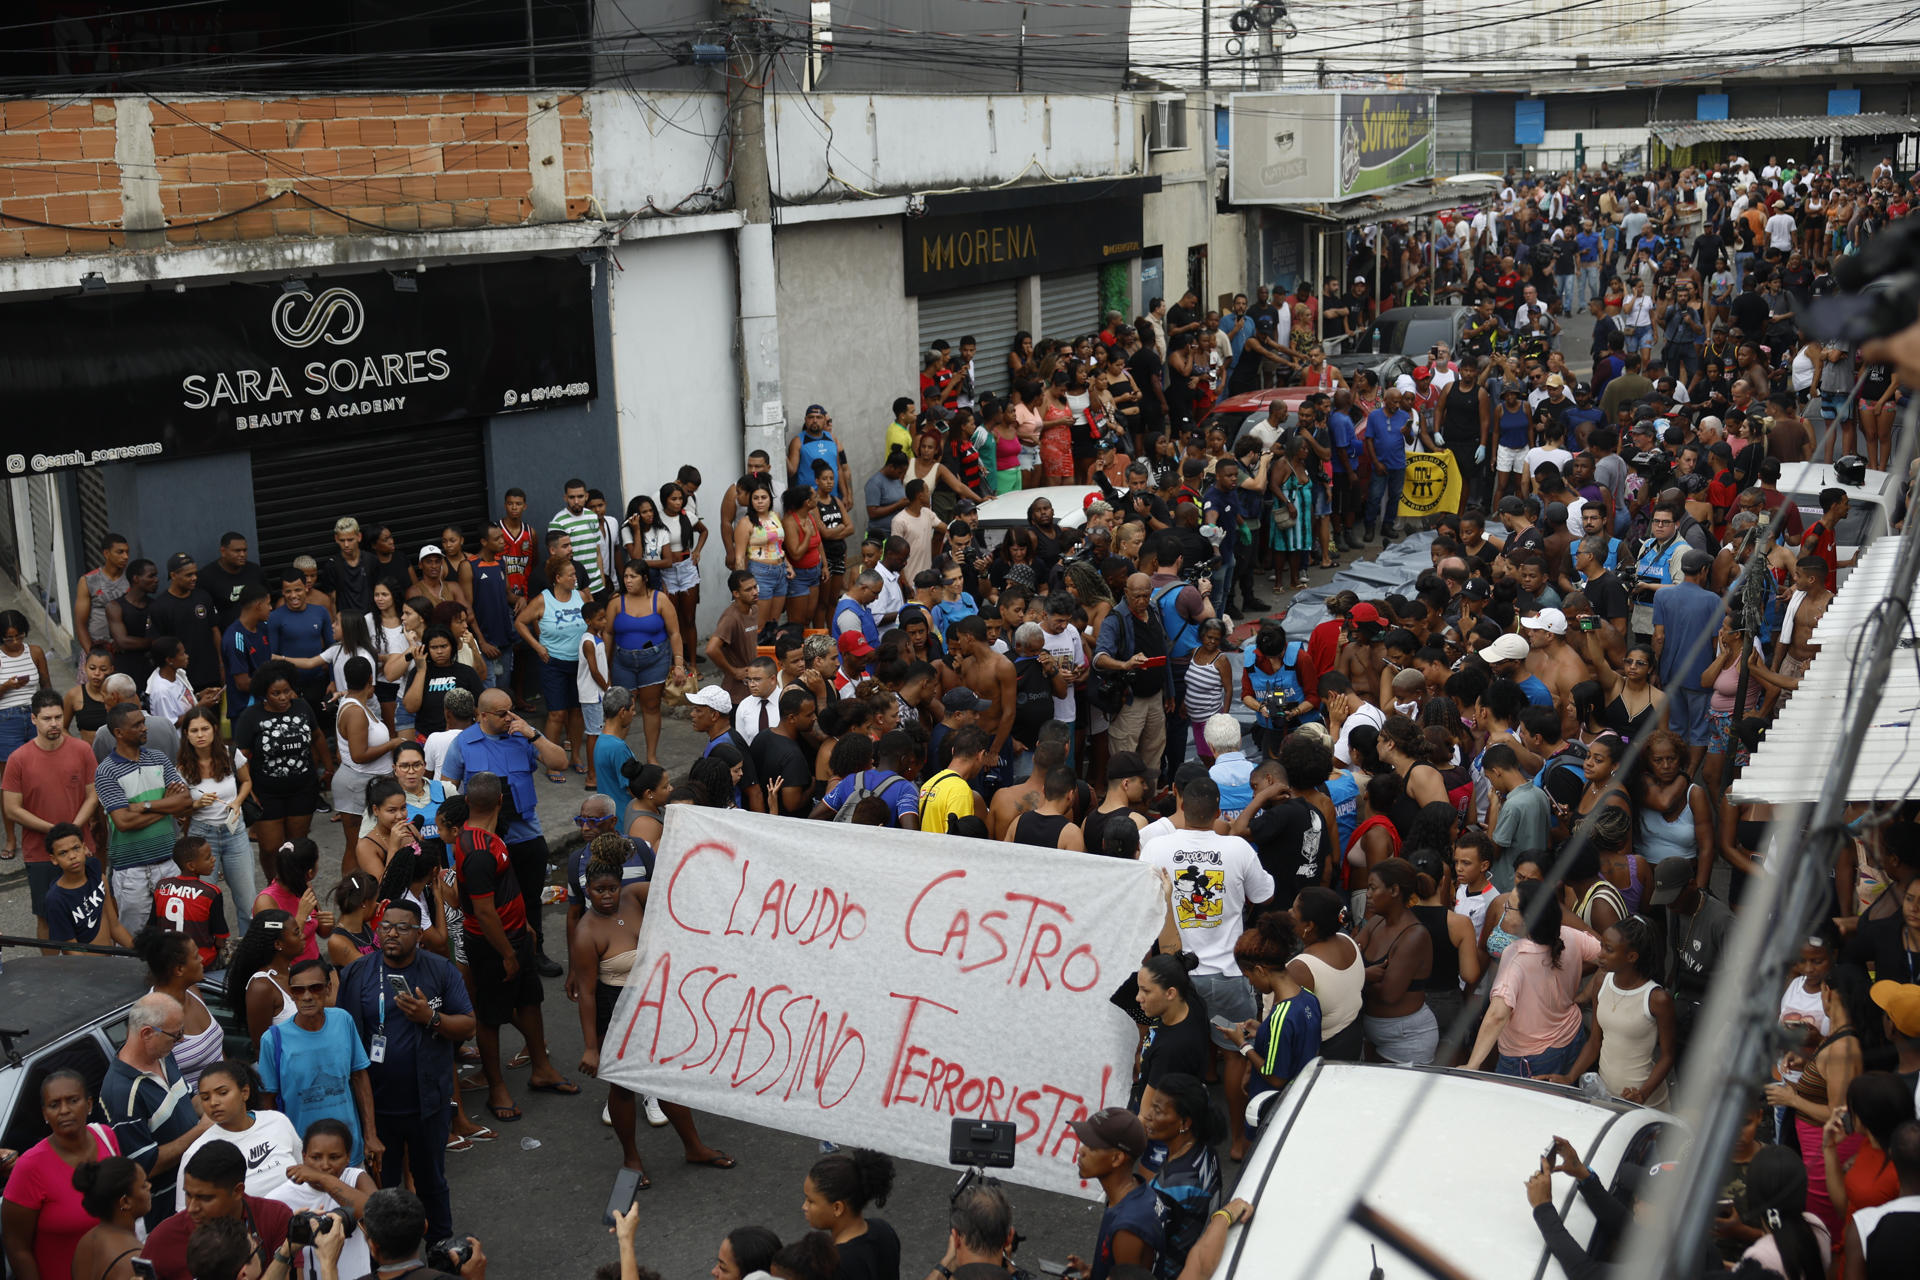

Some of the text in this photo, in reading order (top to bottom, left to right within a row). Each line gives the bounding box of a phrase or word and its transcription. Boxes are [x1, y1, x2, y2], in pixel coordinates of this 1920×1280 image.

[1361, 97, 1410, 153] Sorvetes
[183, 349, 450, 409] SARA SOARES
[236, 397, 406, 430] BEAUTY & ACADEMY
[282, 742, 301, 751] STAND
[169, 884, 203, 900] MRV
[165, 897, 185, 932] 9
[667, 841, 1100, 992] CLAUDIO CASTRO
[617, 952, 867, 1109] ASSASSINO
[249, 1141, 270, 1160] NIKE
